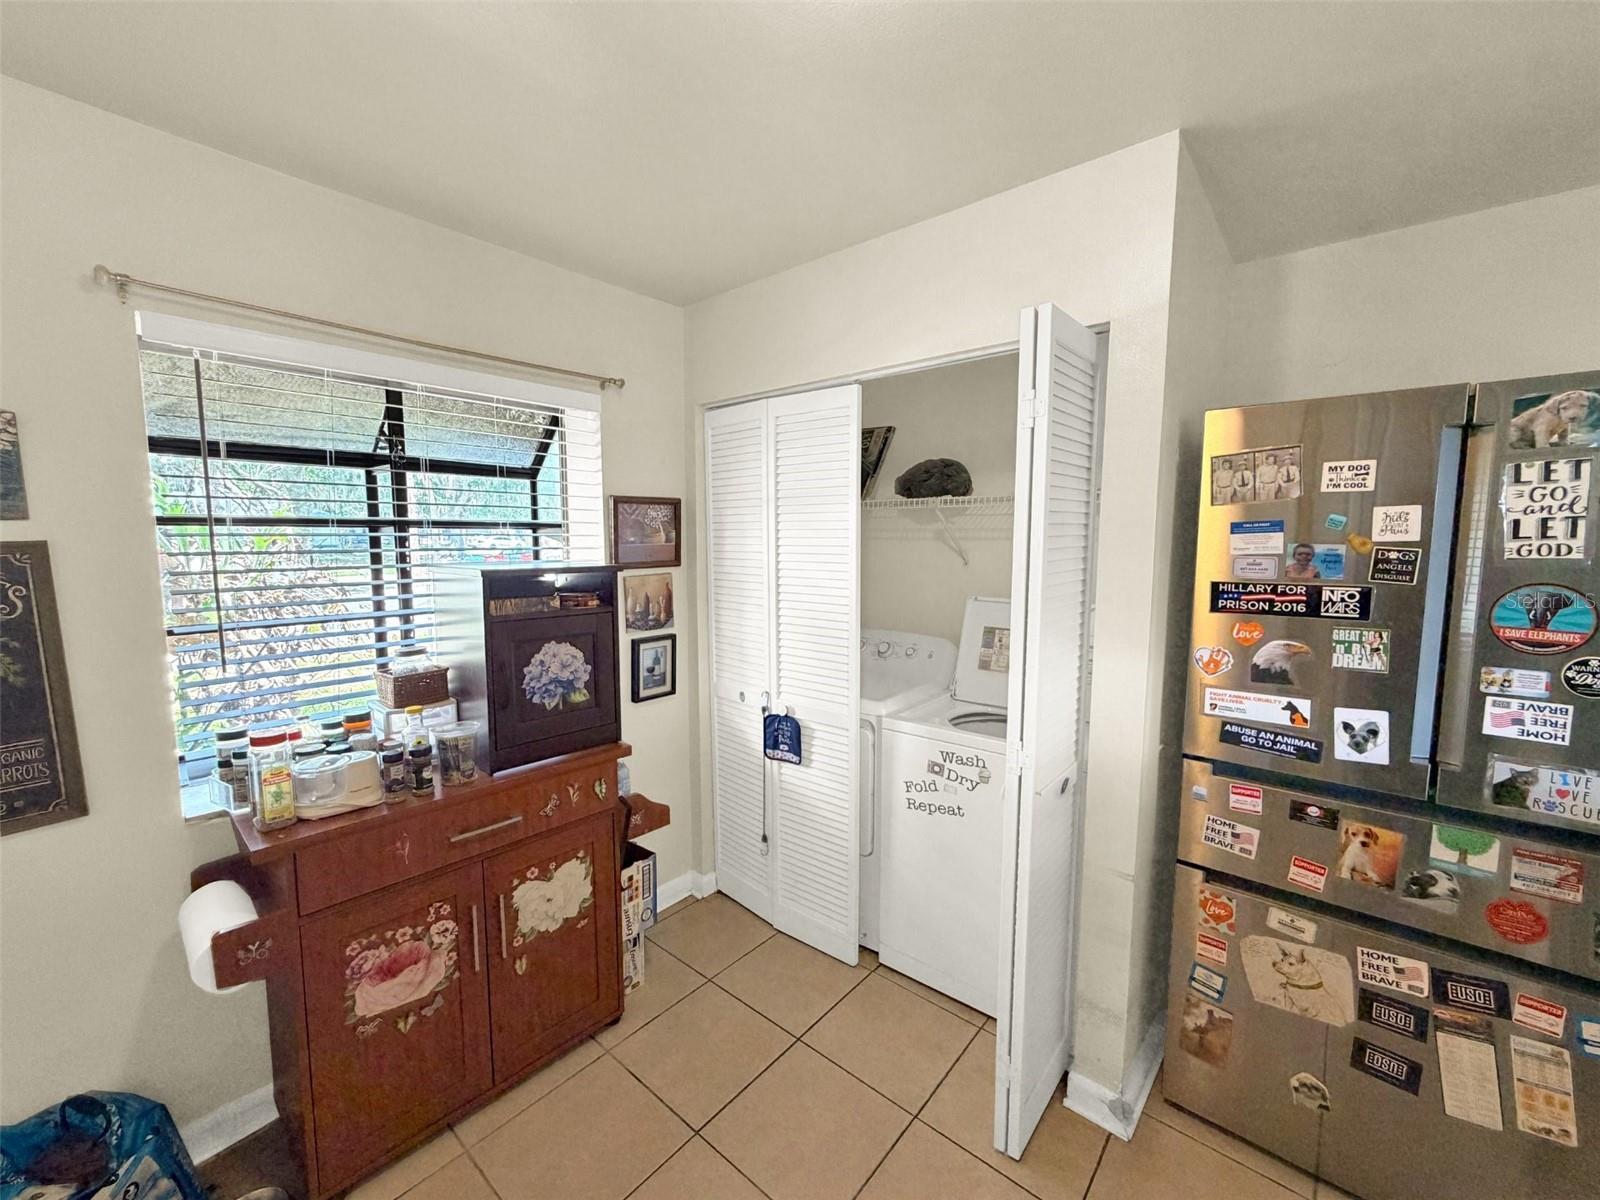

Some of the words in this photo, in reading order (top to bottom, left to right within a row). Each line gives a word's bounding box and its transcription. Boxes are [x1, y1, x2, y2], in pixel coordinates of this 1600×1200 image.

[1347, 464, 1370, 472] DOG
[1507, 459, 1593, 485] LET
[1529, 486, 1568, 503] GO
[1507, 494, 1588, 516] and
[1506, 515, 1585, 540] LET
[1515, 543, 1574, 558] GOD
[1376, 563, 1413, 571] ANGELS
[1374, 573, 1411, 581] DISGUISE
[1218, 583, 1274, 593] HILLARY
[1277, 585, 1307, 595] FOR
[1321, 590, 1361, 602] INFO
[1218, 600, 1269, 611] PRISON
[1273, 602, 1307, 613] 2016
[1320, 602, 1361, 614] WARS
[1333, 629, 1361, 641] GREAT
[1504, 629, 1527, 638] SAVE
[1528, 630, 1581, 643] ELEPHANTS
[1516, 702, 1569, 716] BRAVE
[1530, 717, 1568, 729] FREE
[1224, 724, 1257, 736] ABUSE
[1258, 732, 1275, 740] AN
[1275, 734, 1318, 750] ANIMAL
[1516, 728, 1566, 742] HOME
[1241, 735, 1256, 744] GO
[1257, 739, 1272, 747] TO
[1273, 742, 1297, 753] JAIL
[939, 750, 987, 768] Wash
[904, 780, 939, 793] Fold
[945, 767, 980, 792] Dry
[1550, 772, 1593, 790] LIVE
[1548, 786, 1591, 804] LVE
[905, 797, 965, 818] Repeat
[1207, 816, 1238, 831] HOME
[1206, 826, 1229, 838] FREE
[1203, 835, 1236, 851] BRAVE
[1361, 950, 1399, 965] HOME
[1361, 960, 1390, 974] FREE
[1361, 972, 1402, 989] BRAVE
[1457, 985, 1485, 1004] USO
[1381, 1007, 1405, 1027] USO
[1373, 1053, 1399, 1073] USO
